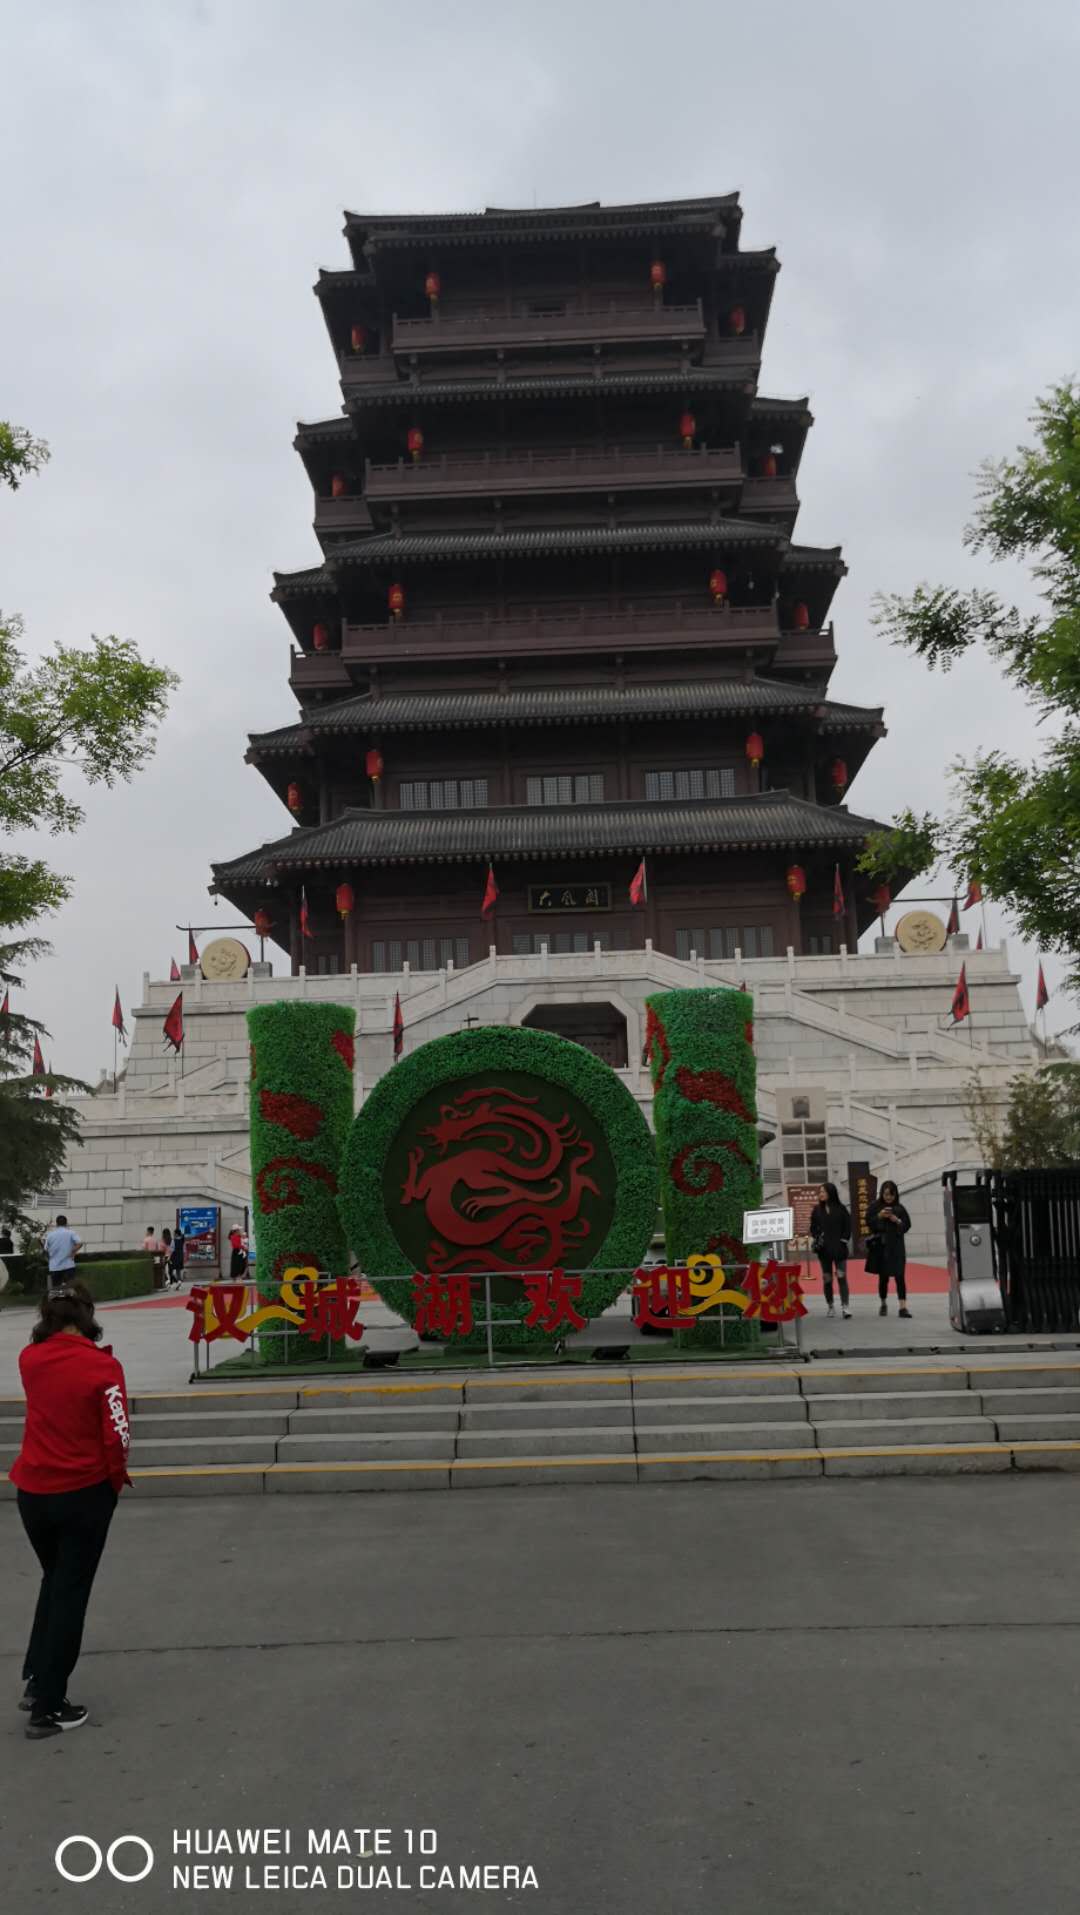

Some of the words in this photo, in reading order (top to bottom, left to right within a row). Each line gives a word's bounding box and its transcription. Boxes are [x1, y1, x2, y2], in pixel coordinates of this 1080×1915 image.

[184, 1258, 809, 1344] 汉城湖欢迎您
[104, 1384, 130, 1448] Kappa
